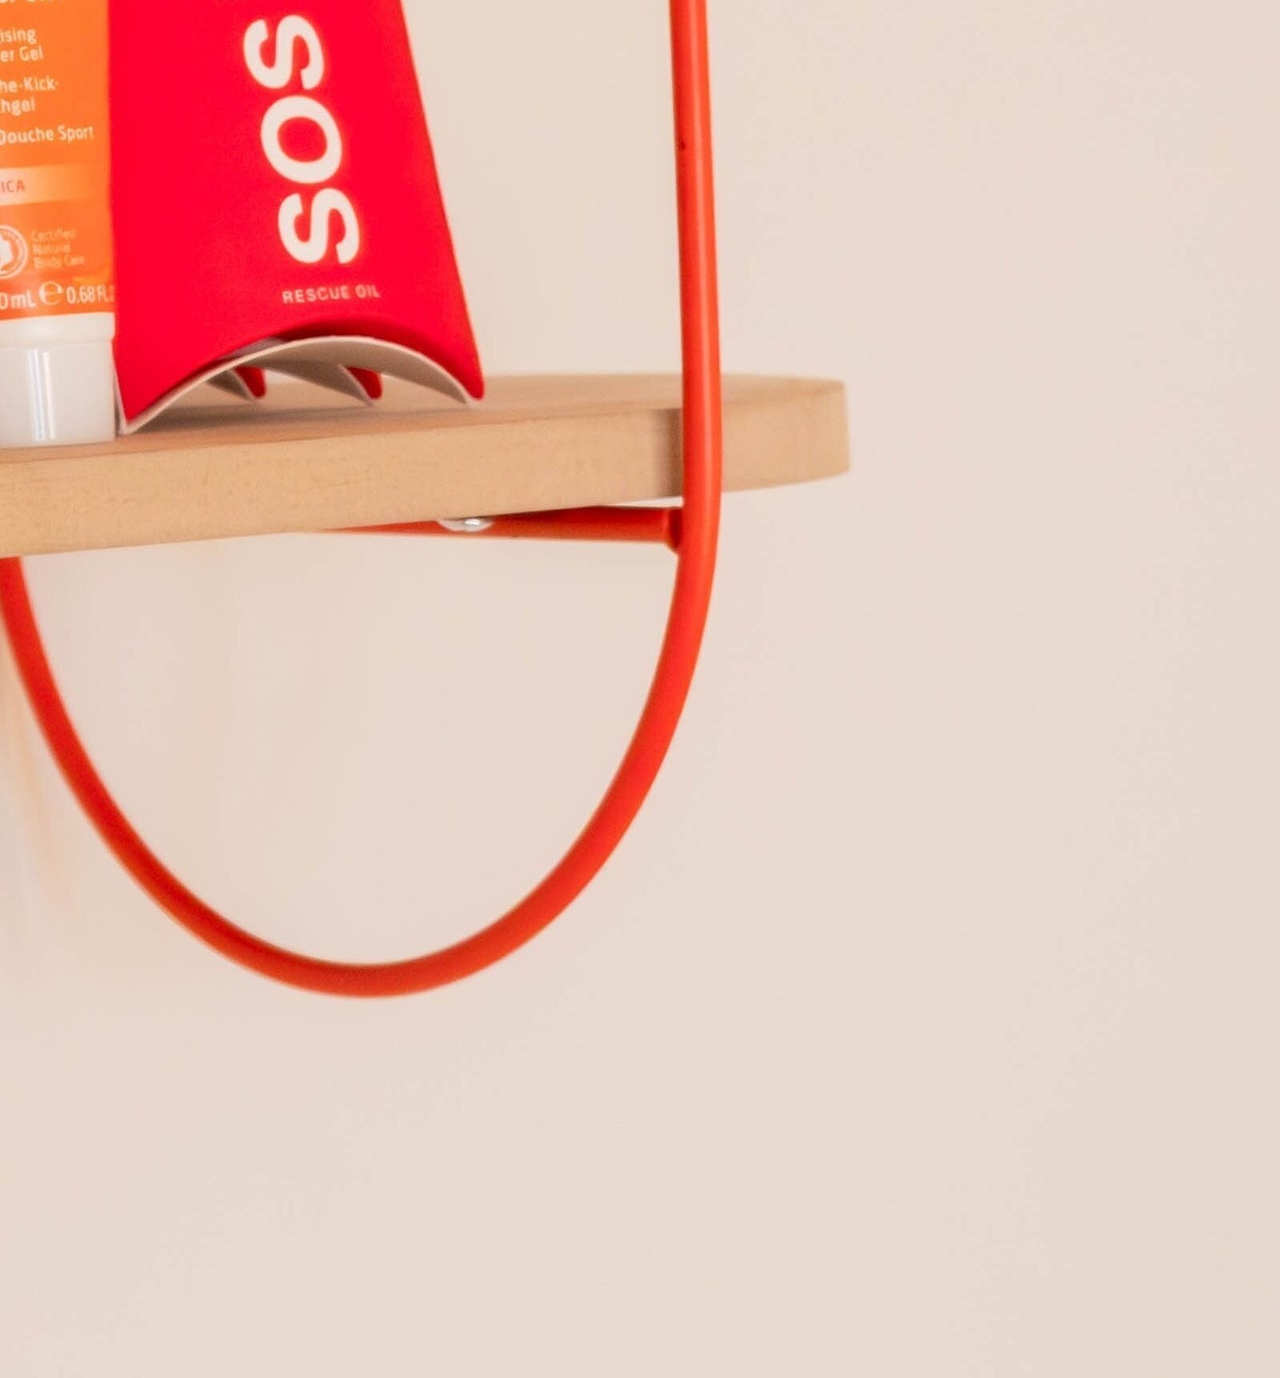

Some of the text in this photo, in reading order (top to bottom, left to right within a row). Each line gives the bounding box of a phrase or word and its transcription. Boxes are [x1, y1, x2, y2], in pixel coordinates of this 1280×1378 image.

[19, 46, 43, 62] Gel
[57, 125, 94, 143] Sport
[243, 15, 360, 265] SOS
[282, 283, 381, 304] RESCUE OIL
